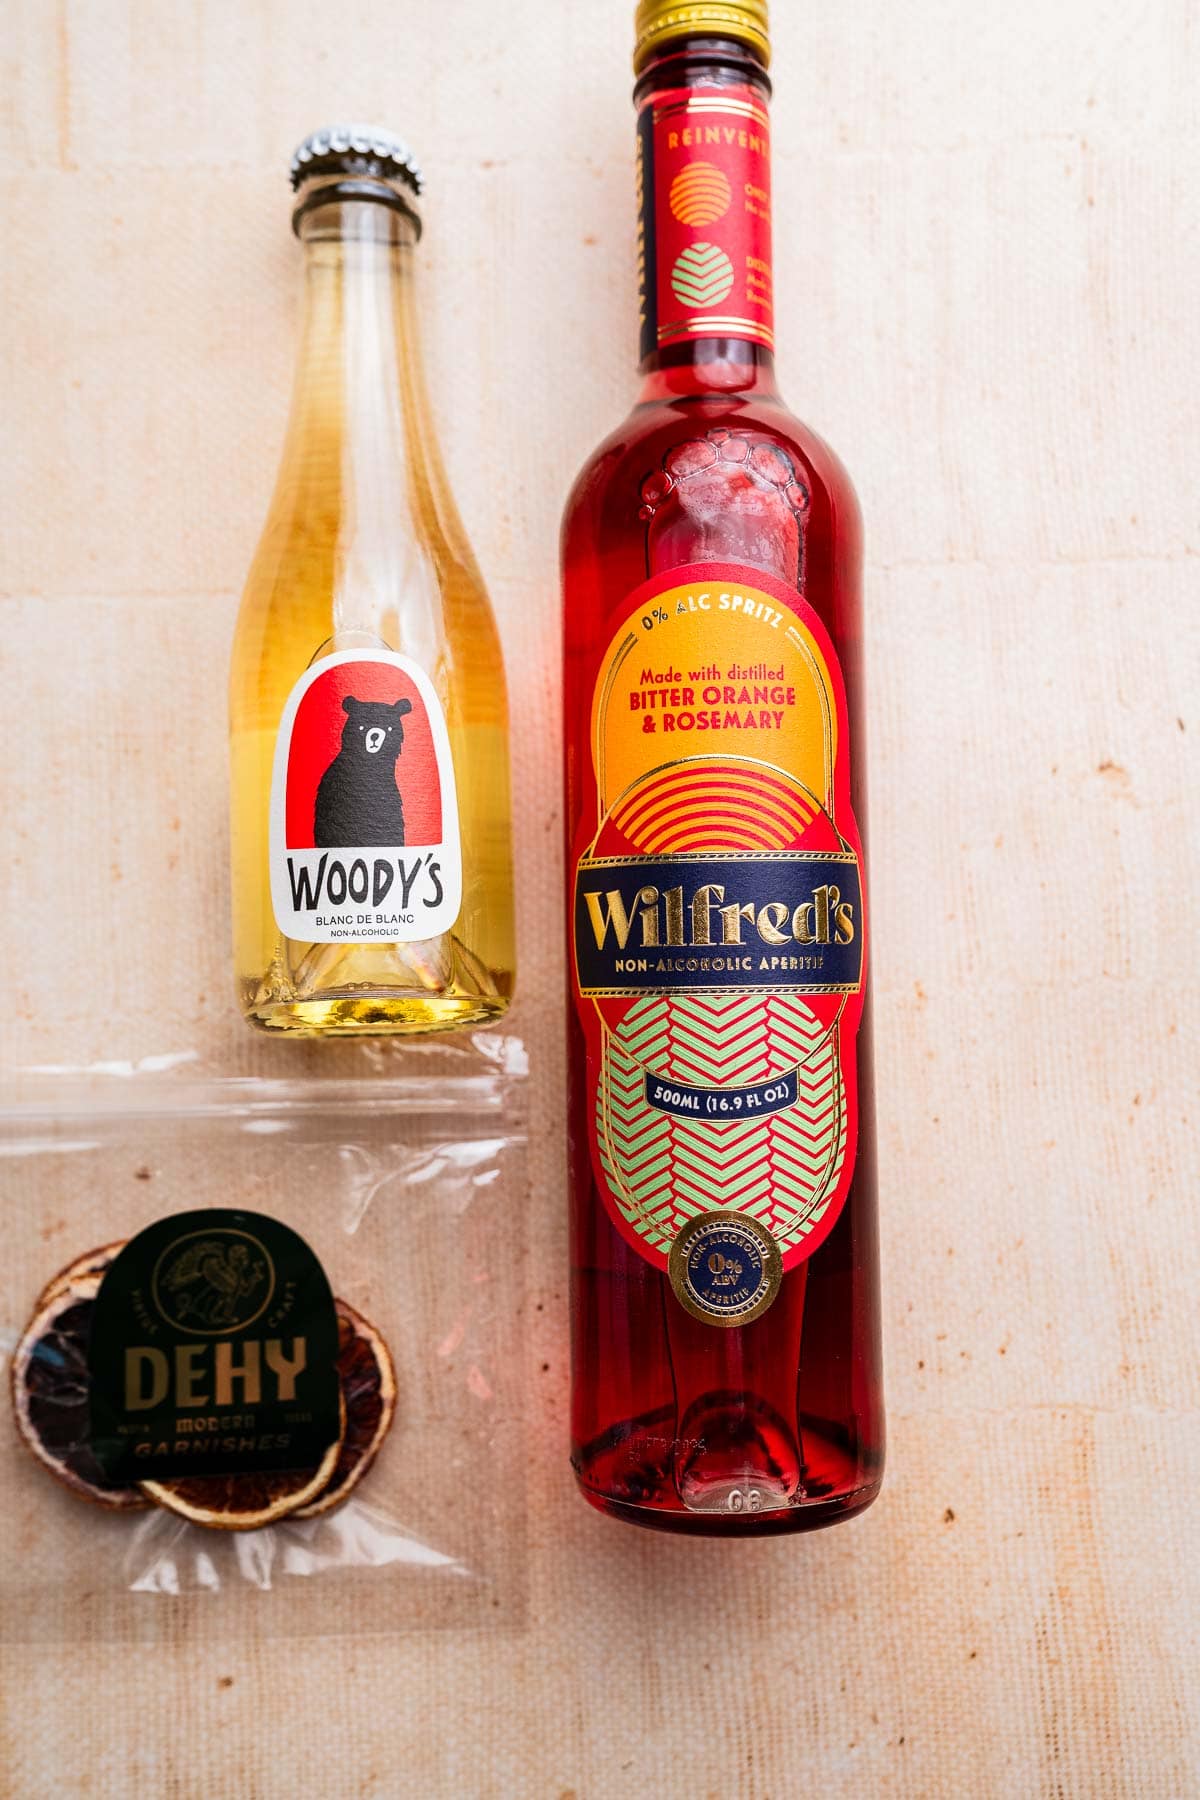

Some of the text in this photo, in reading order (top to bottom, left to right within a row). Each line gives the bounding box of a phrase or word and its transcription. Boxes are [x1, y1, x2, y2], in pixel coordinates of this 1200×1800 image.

[642, 594, 784, 630] 0% ALC SPRITZ
[640, 664, 785, 685] Made with distilled
[629, 686, 796, 711] BITTER ORANGE
[642, 710, 785, 734] & ROSEMARY
[287, 852, 444, 911] WOODY'S
[316, 914, 415, 926] BLANC DE BLANC
[583, 884, 854, 950] Wilfred's
[330, 929, 399, 937] NON-ALCOHOLIC
[615, 956, 824, 973] NON-ALCOHOLIC APERITIF
[654, 1082, 790, 1113] 500ML (16.9 FL OZ)
[708, 1253, 743, 1275] 0%
[124, 1336, 307, 1412] DEHY
[134, 1434, 291, 1458] GARNISHES
